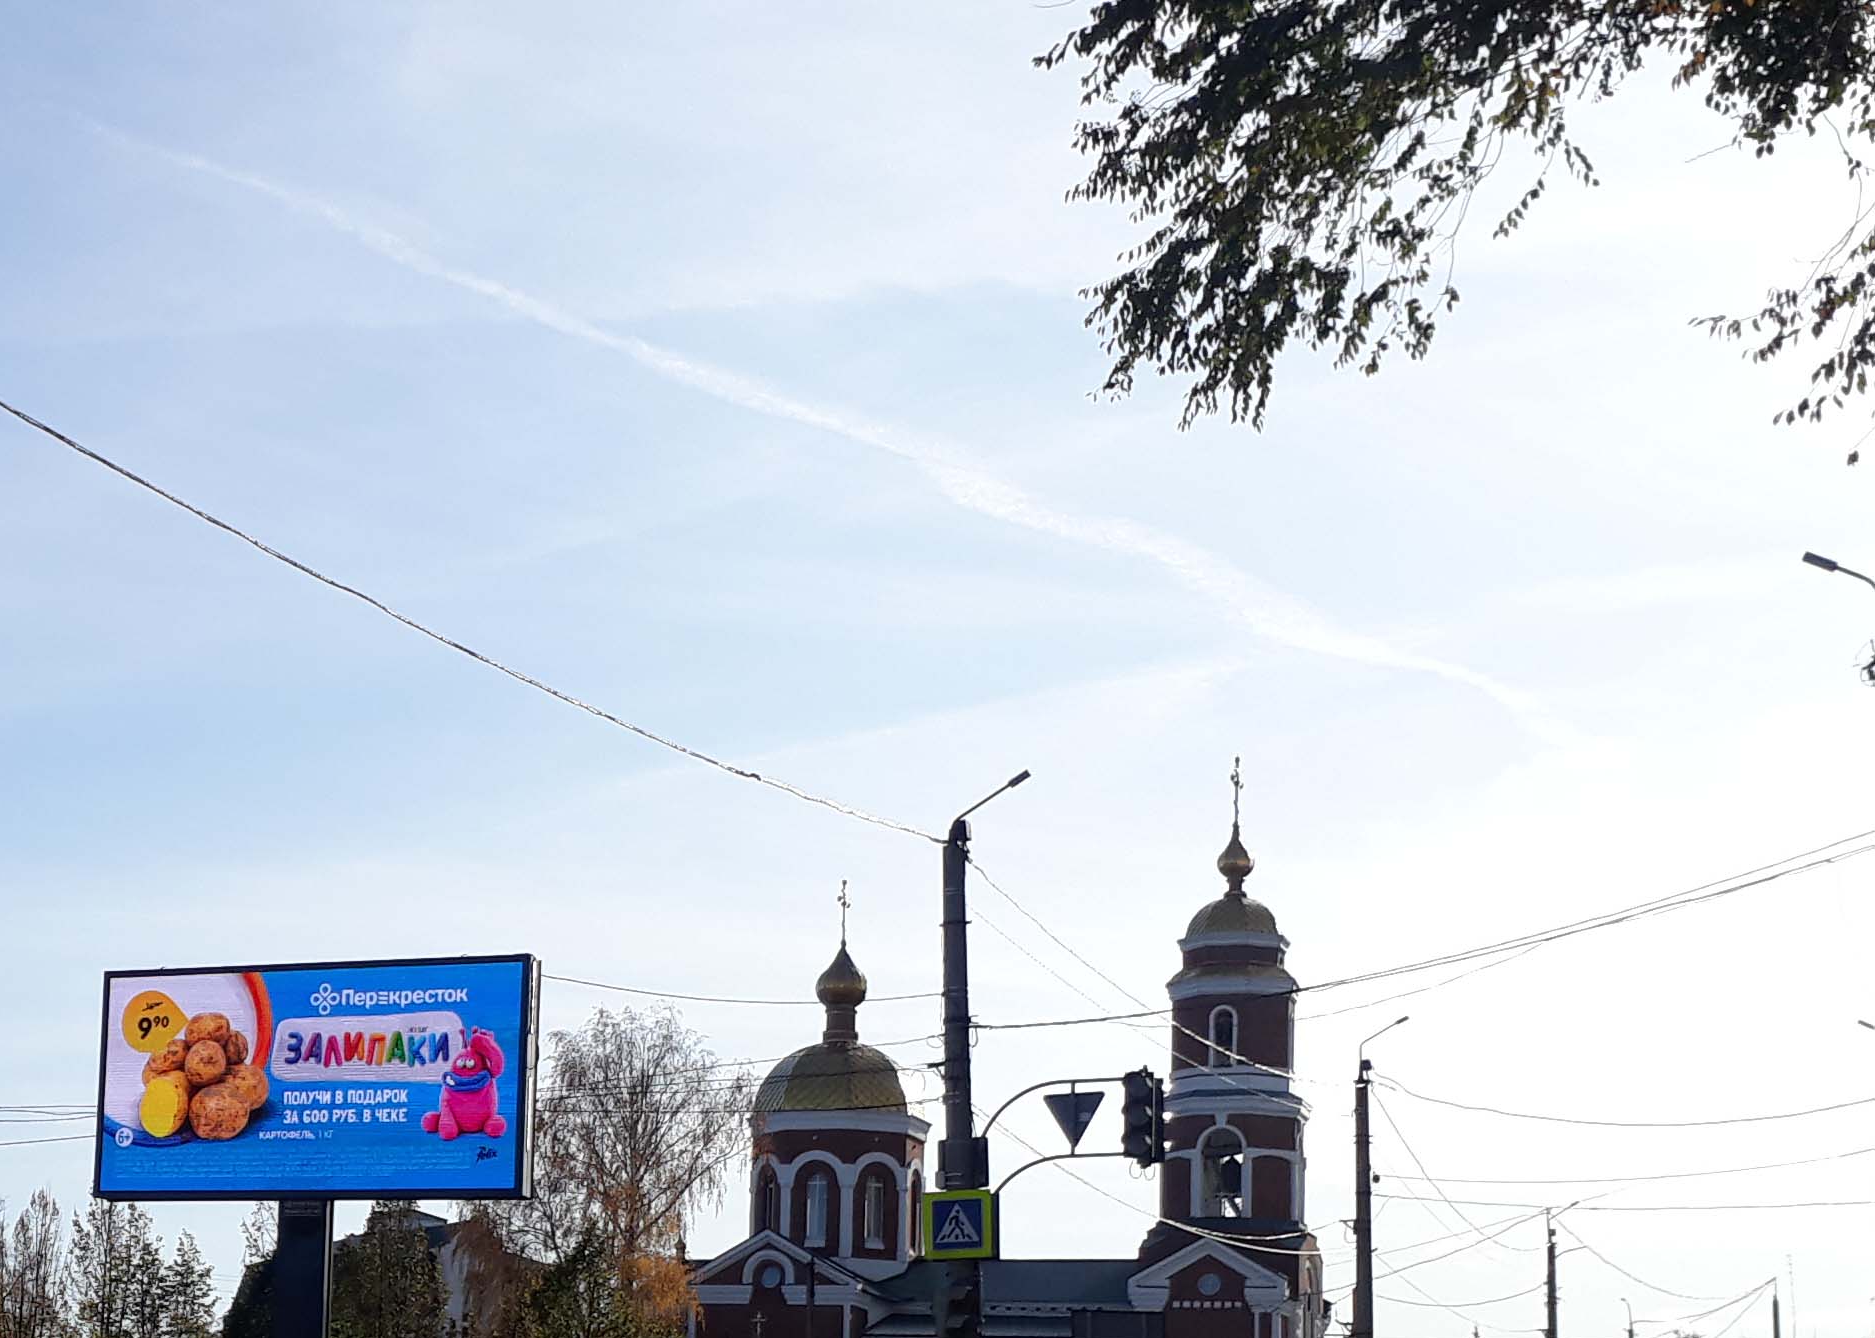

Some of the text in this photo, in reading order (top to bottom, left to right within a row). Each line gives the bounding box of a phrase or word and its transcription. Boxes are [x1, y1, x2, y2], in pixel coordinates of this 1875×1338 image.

[284, 1030, 450, 1068] ЗАЛИПАКИ
[283, 1089, 408, 1105] ПОЛУЧИ В ПОДАРОК
[283, 1108, 408, 1124] ЗА 600 РУБ. В ЧЕКЕ
[118, 1131, 130, 1144] 6+
